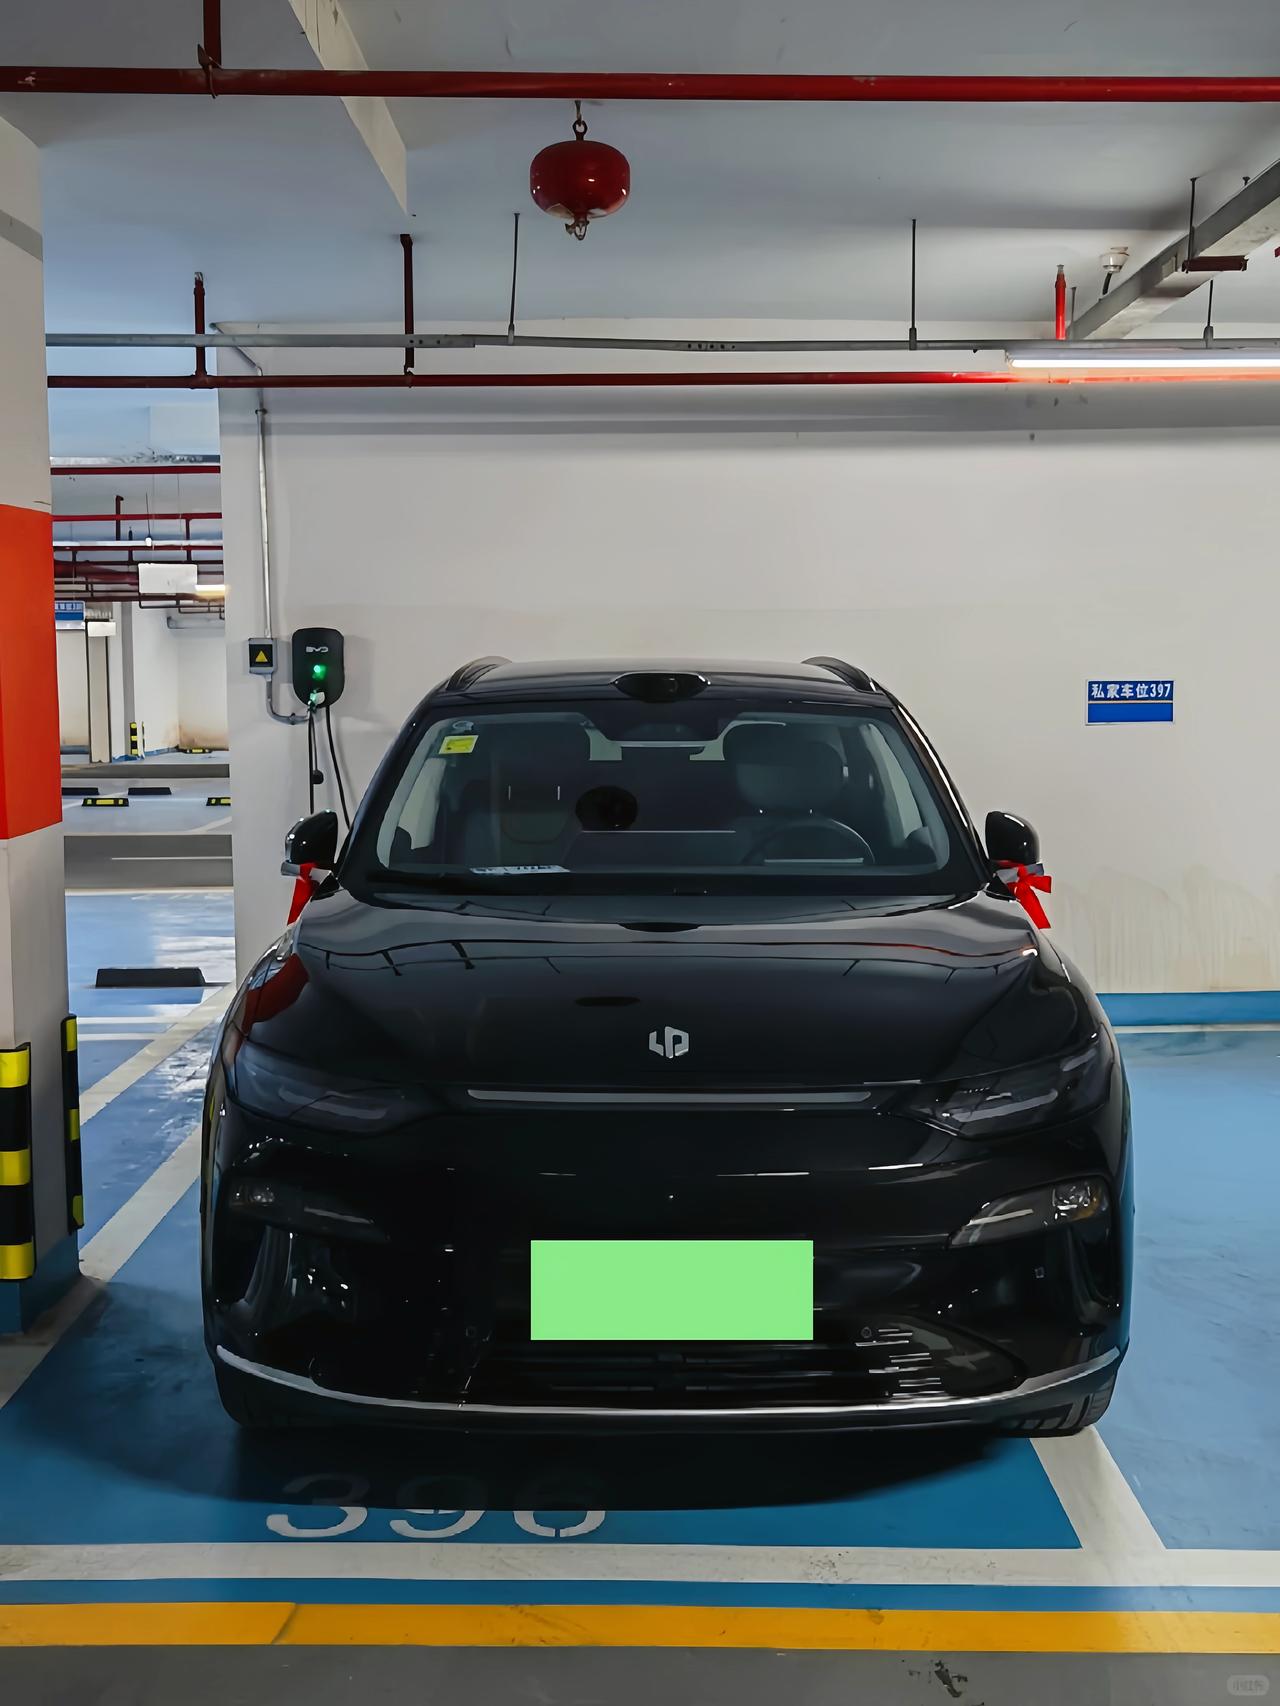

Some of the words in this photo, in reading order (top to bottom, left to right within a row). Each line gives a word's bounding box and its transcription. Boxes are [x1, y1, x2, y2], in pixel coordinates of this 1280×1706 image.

[1091, 683, 1171, 699] 私家车位397
[266, 1472, 606, 1538] 396
